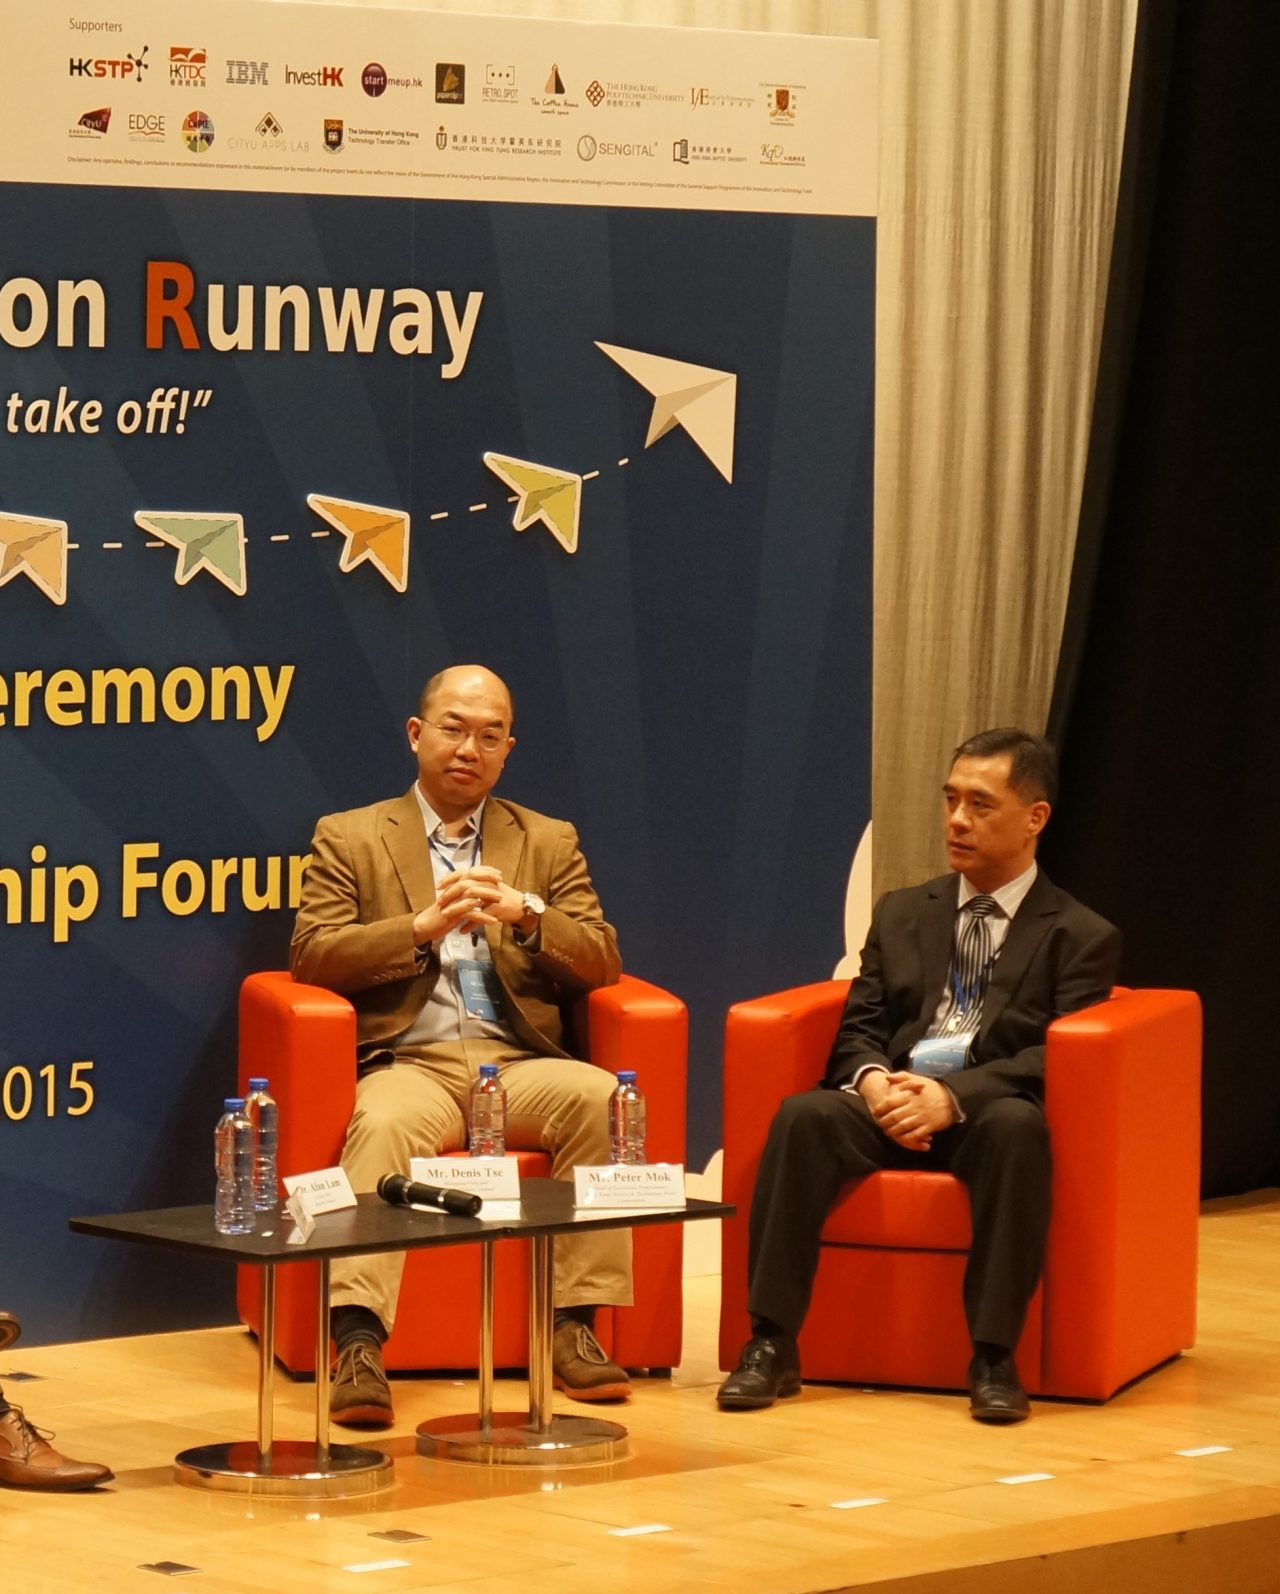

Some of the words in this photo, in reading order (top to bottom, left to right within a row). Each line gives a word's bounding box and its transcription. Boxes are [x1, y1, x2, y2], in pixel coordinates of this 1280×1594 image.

[69, 18, 123, 33] Supporters
[69, 58, 134, 79] HKSTP
[170, 64, 206, 79] HKTDC
[226, 60, 269, 85] IBM
[285, 64, 344, 87] InvestHK
[129, 114, 166, 131] EDGE
[145, 260, 484, 380] Runway
[6, 386, 101, 434] take
[117, 386, 213, 436] off!”
[427, 1168, 448, 1179] Mr.
[451, 1167, 481, 1178] Denis
[484, 1167, 504, 1177] Tse
[613, 1172, 642, 1183] Peter
[646, 1172, 672, 1182] Mok
